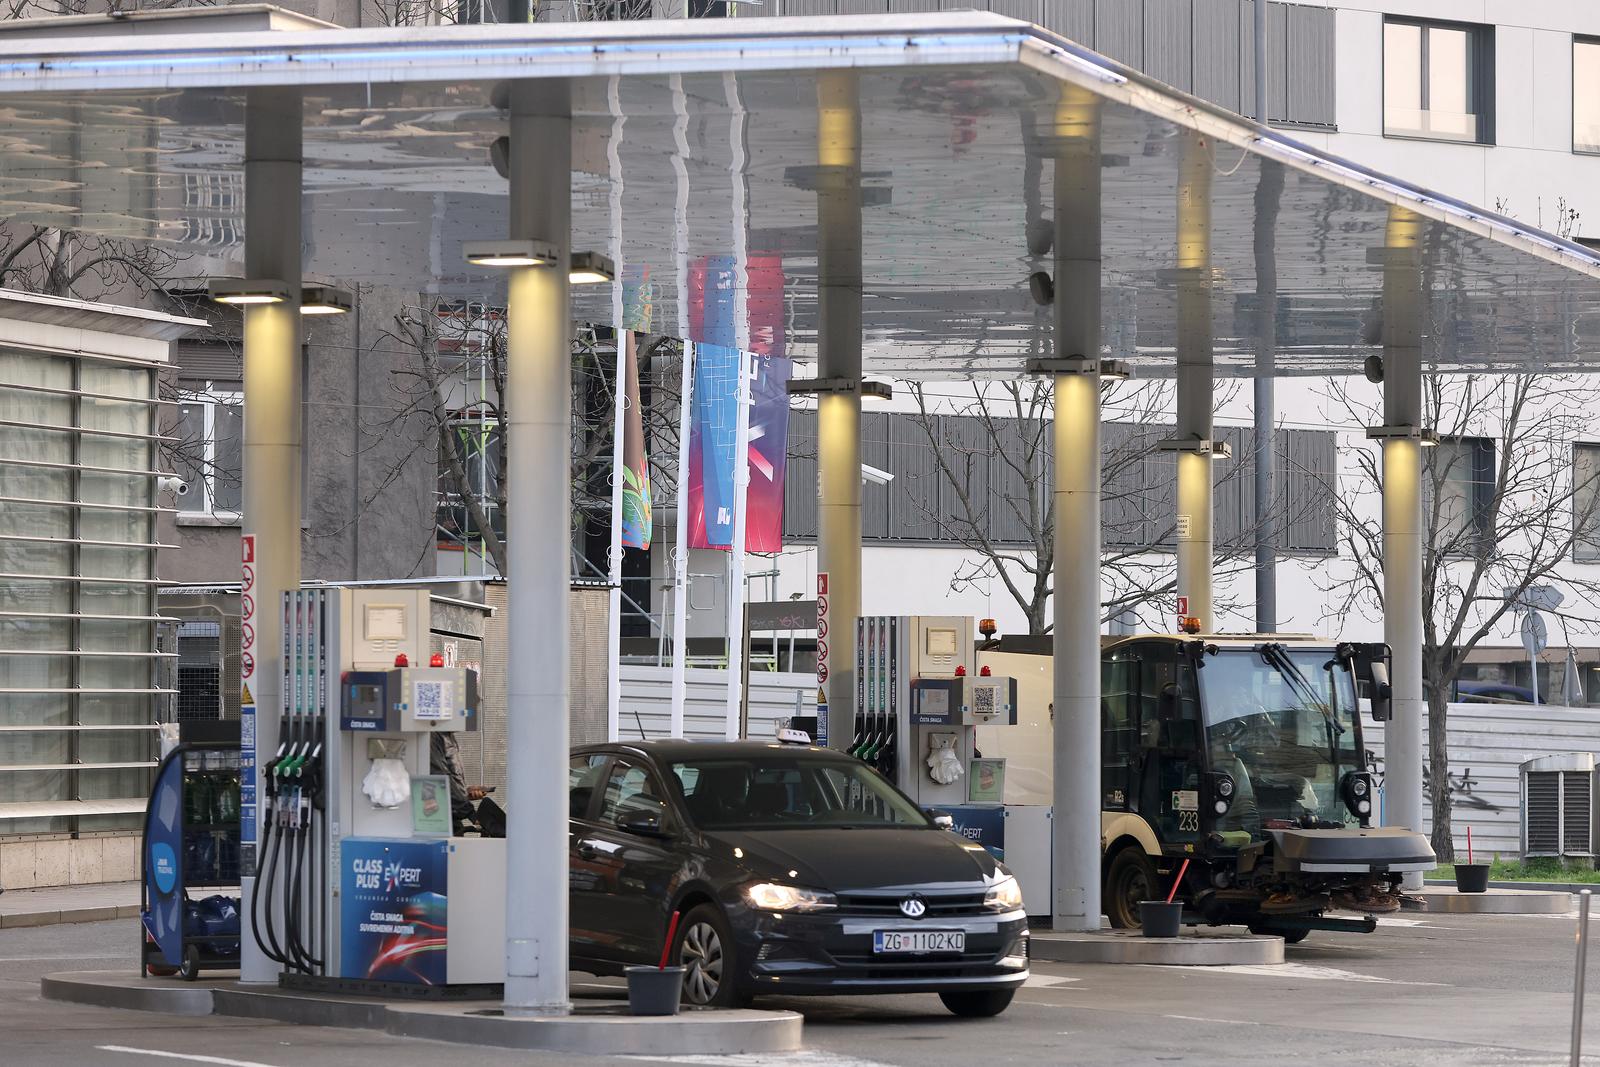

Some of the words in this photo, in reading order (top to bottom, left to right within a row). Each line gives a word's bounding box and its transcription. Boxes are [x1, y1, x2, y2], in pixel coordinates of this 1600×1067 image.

[1179, 811, 1199, 831] 233
[353, 859, 383, 874] CLASS
[356, 874, 380, 888] PLUS
[384, 863, 421, 892] EXPERT
[885, 933, 902, 950] ZG
